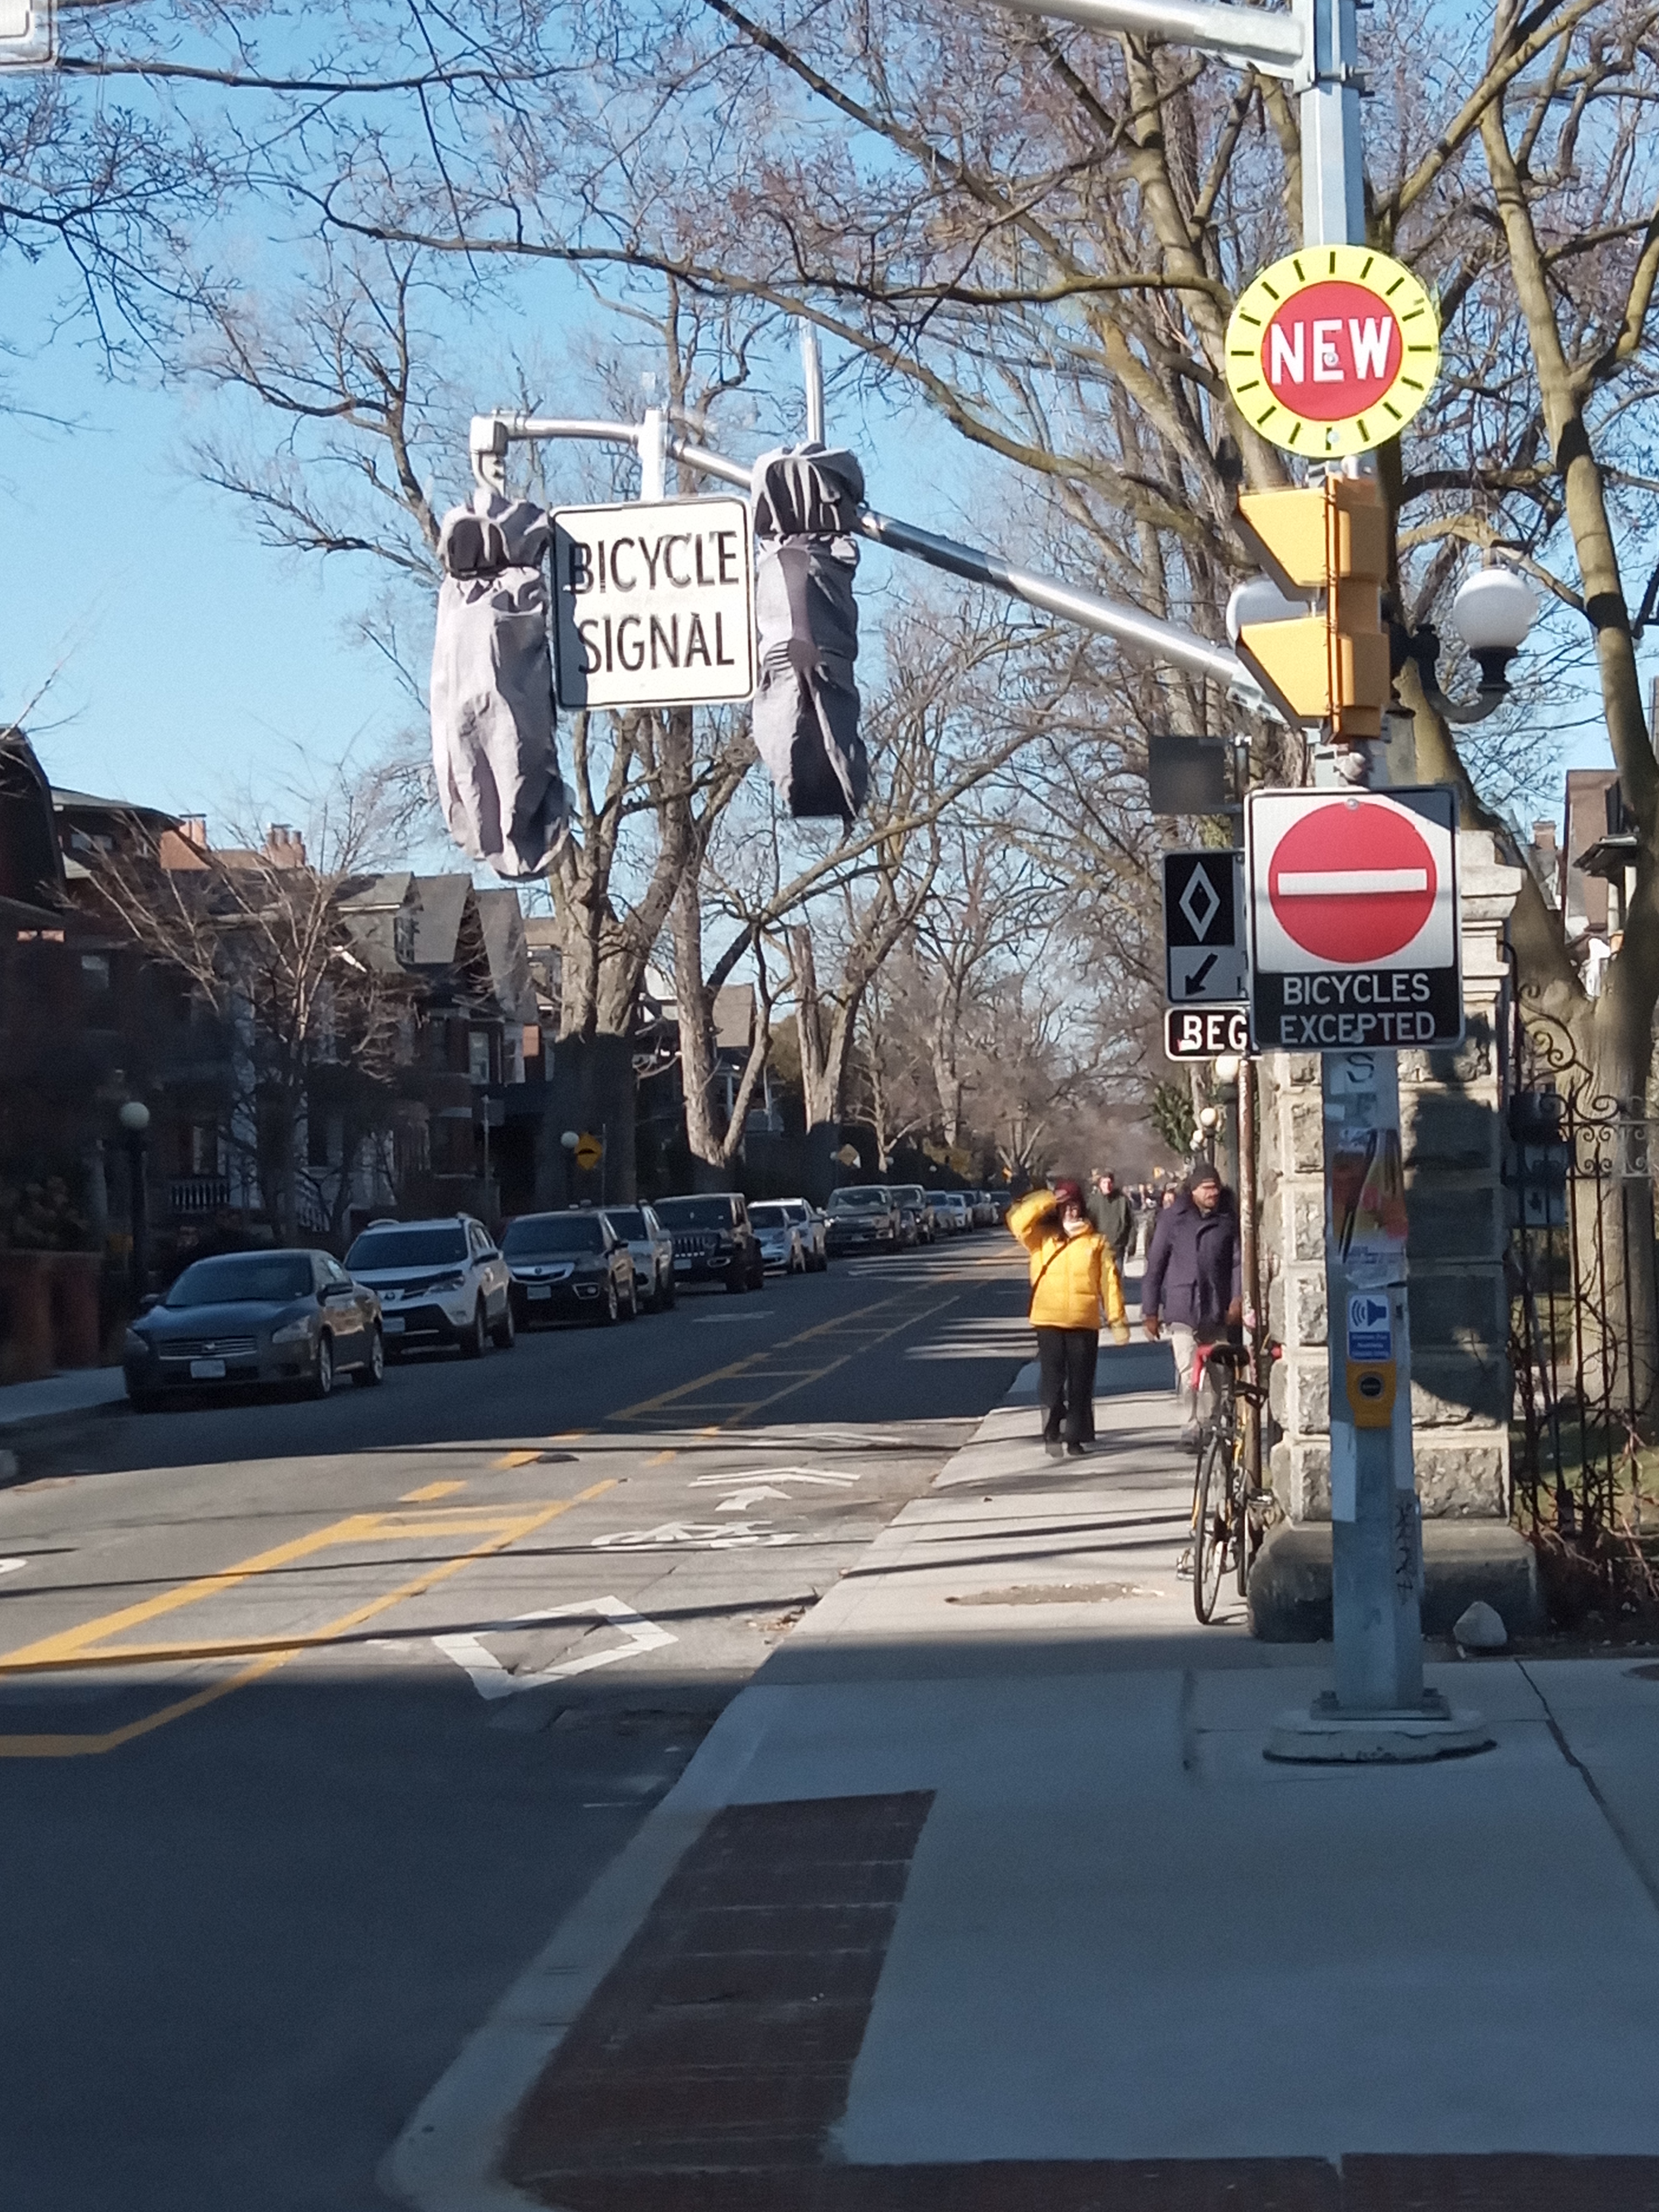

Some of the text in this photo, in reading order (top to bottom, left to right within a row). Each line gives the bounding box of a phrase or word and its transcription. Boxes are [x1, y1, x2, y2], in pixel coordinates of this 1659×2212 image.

[1271, 316, 1392, 385] NEW
[569, 531, 739, 595] BICYCLE
[578, 612, 735, 674] SIGNAL
[1283, 973, 1431, 1006] BICYCLES
[1280, 1011, 1435, 1045] EXCEPTED
